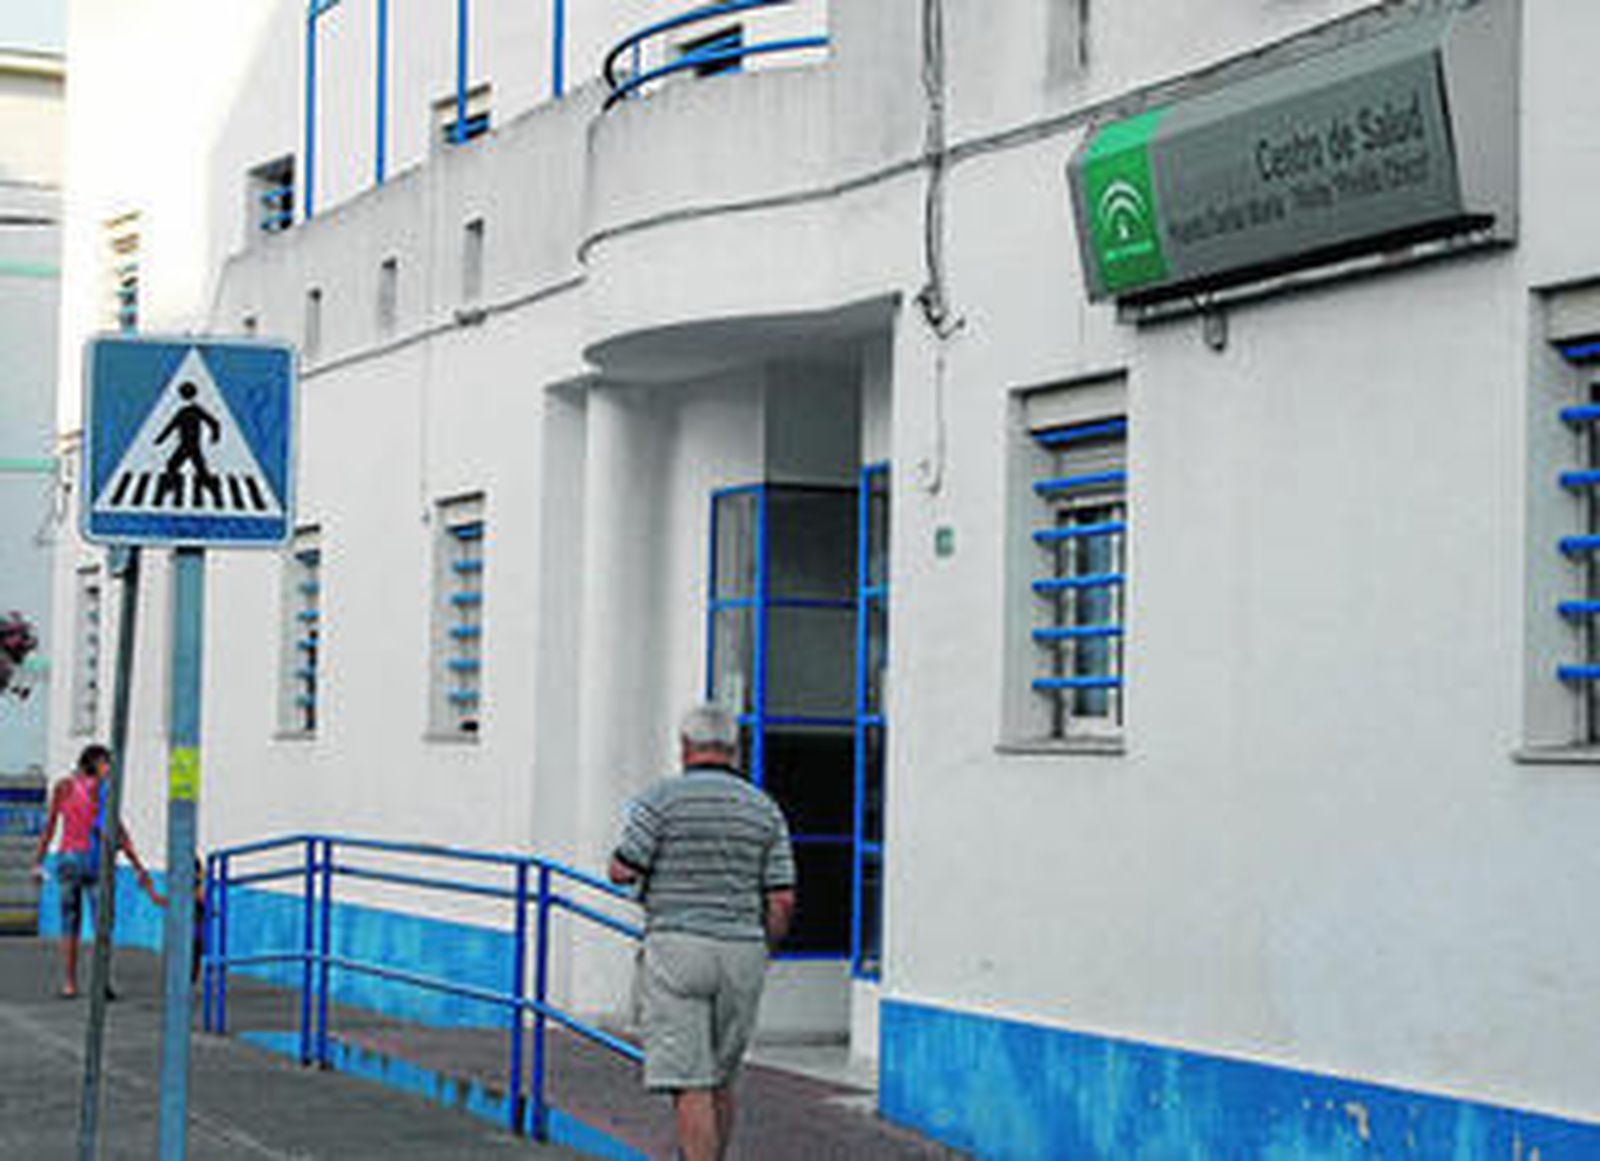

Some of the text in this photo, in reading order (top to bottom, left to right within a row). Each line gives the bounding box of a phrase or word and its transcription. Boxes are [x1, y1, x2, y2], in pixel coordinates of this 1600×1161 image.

[1255, 134, 1323, 182] Centro
[1330, 118, 1355, 160] de
[1357, 91, 1425, 150] Salud
